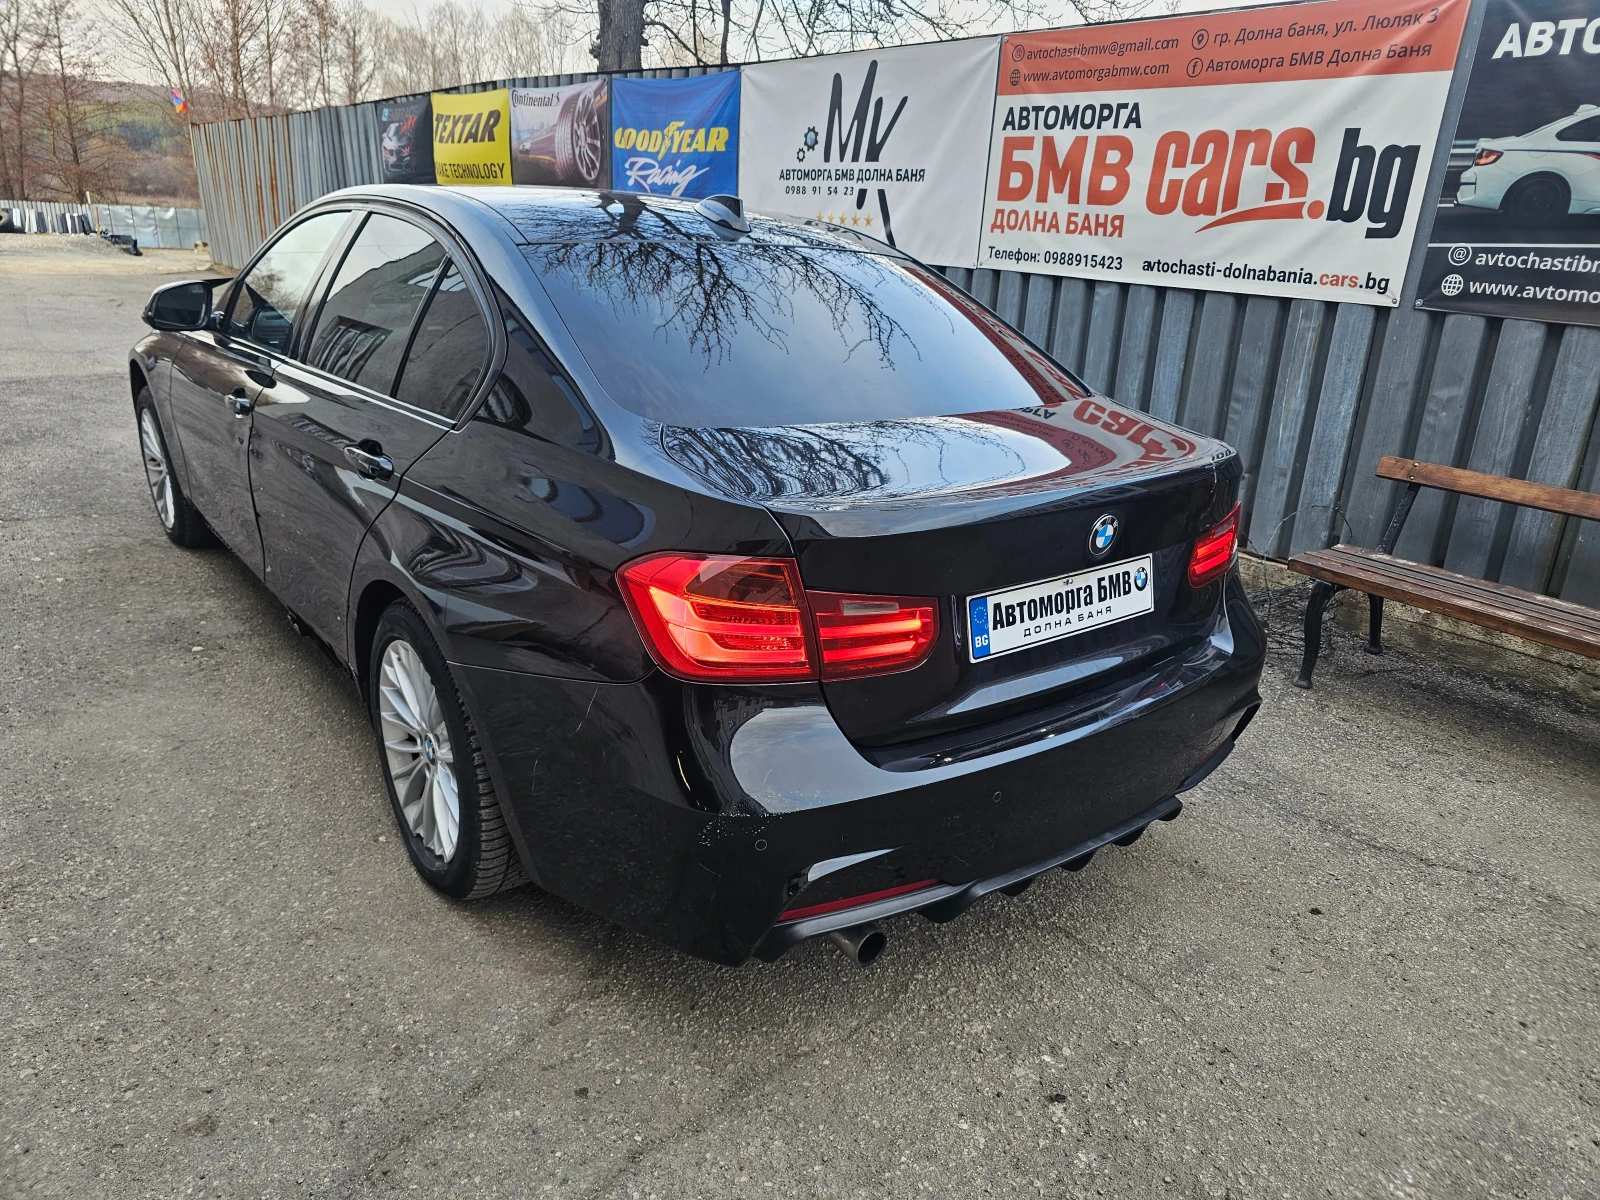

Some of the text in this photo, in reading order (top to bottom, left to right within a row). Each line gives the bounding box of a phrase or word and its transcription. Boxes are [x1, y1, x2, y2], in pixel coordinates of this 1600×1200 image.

[1213, 8, 1440, 47] гр. Долна баня, ул. Люляк 3
[1027, 36, 1179, 60] avtochastibmw@gmail.com
[1205, 43, 1433, 75] Автоморга БМВ Долна Баня
[1023, 62, 1170, 82] www.avtomorgabmw.com
[511, 90, 554, 107] Continental
[434, 109, 501, 144] TEXTAR
[1002, 102, 1142, 131] АВТОМОРГА
[614, 124, 729, 155] GOODYEAR
[448, 162, 505, 180] TECHNOLOGY
[624, 157, 710, 197] Racing
[779, 168, 926, 184] АВТОМОРГА БМВ ДОЛНА БАНЯ
[997, 135, 1134, 206] БМВ
[785, 186, 855, 196] 0988 91 54 23
[990, 208, 1125, 238] ДОЛНА БАНЯ
[988, 246, 1123, 271] Телефон: 0988915423
[1142, 259, 1390, 294] avtochasti-dolnabania.cars.bg
[992, 570, 1132, 631] Автоморга БМВ
[1023, 605, 1112, 638] ДОЛНА БАНЯ
[975, 633, 989, 648] BG
